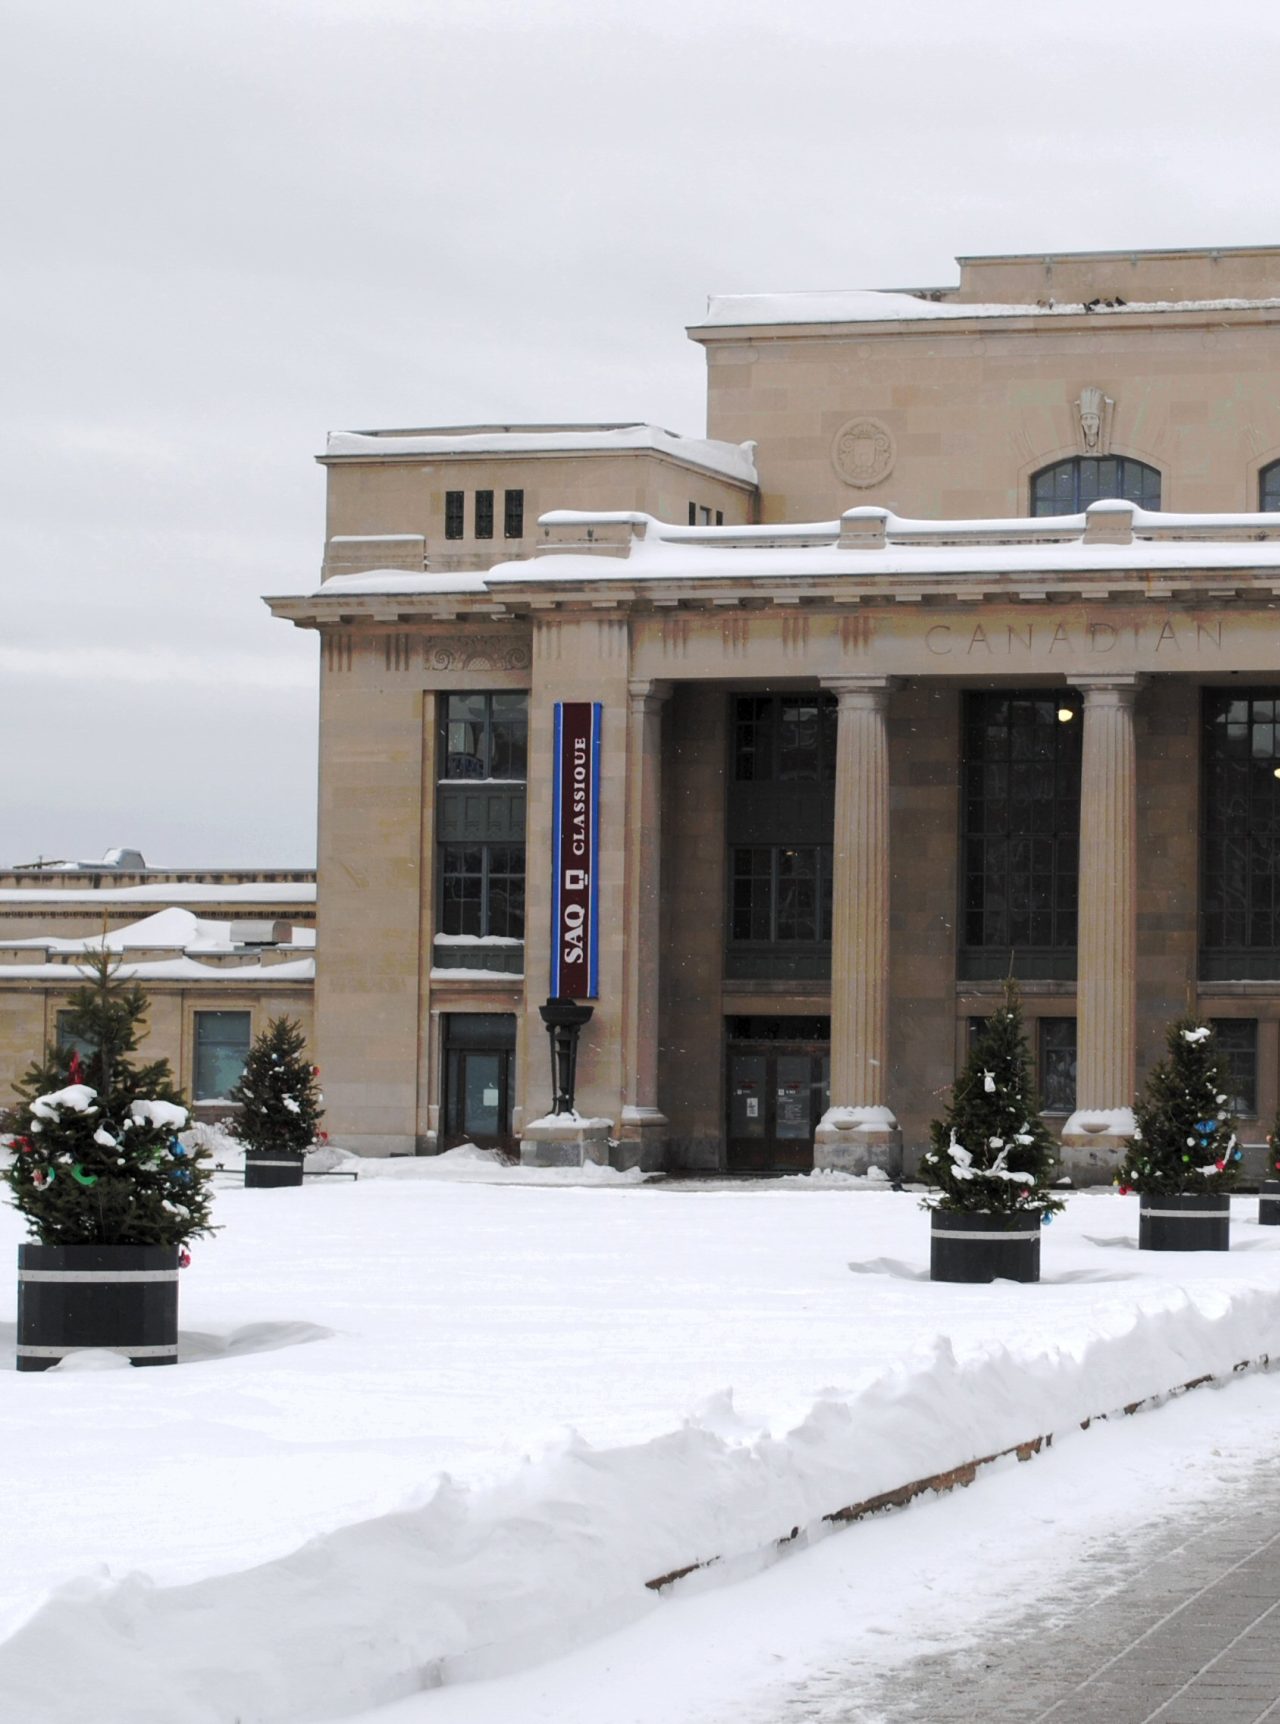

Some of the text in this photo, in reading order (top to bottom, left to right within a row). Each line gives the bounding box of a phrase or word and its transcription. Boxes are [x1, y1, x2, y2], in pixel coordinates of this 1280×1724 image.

[924, 619, 1224, 656] CANADIAN
[564, 737, 586, 964] SAQ CLASSIQUE
